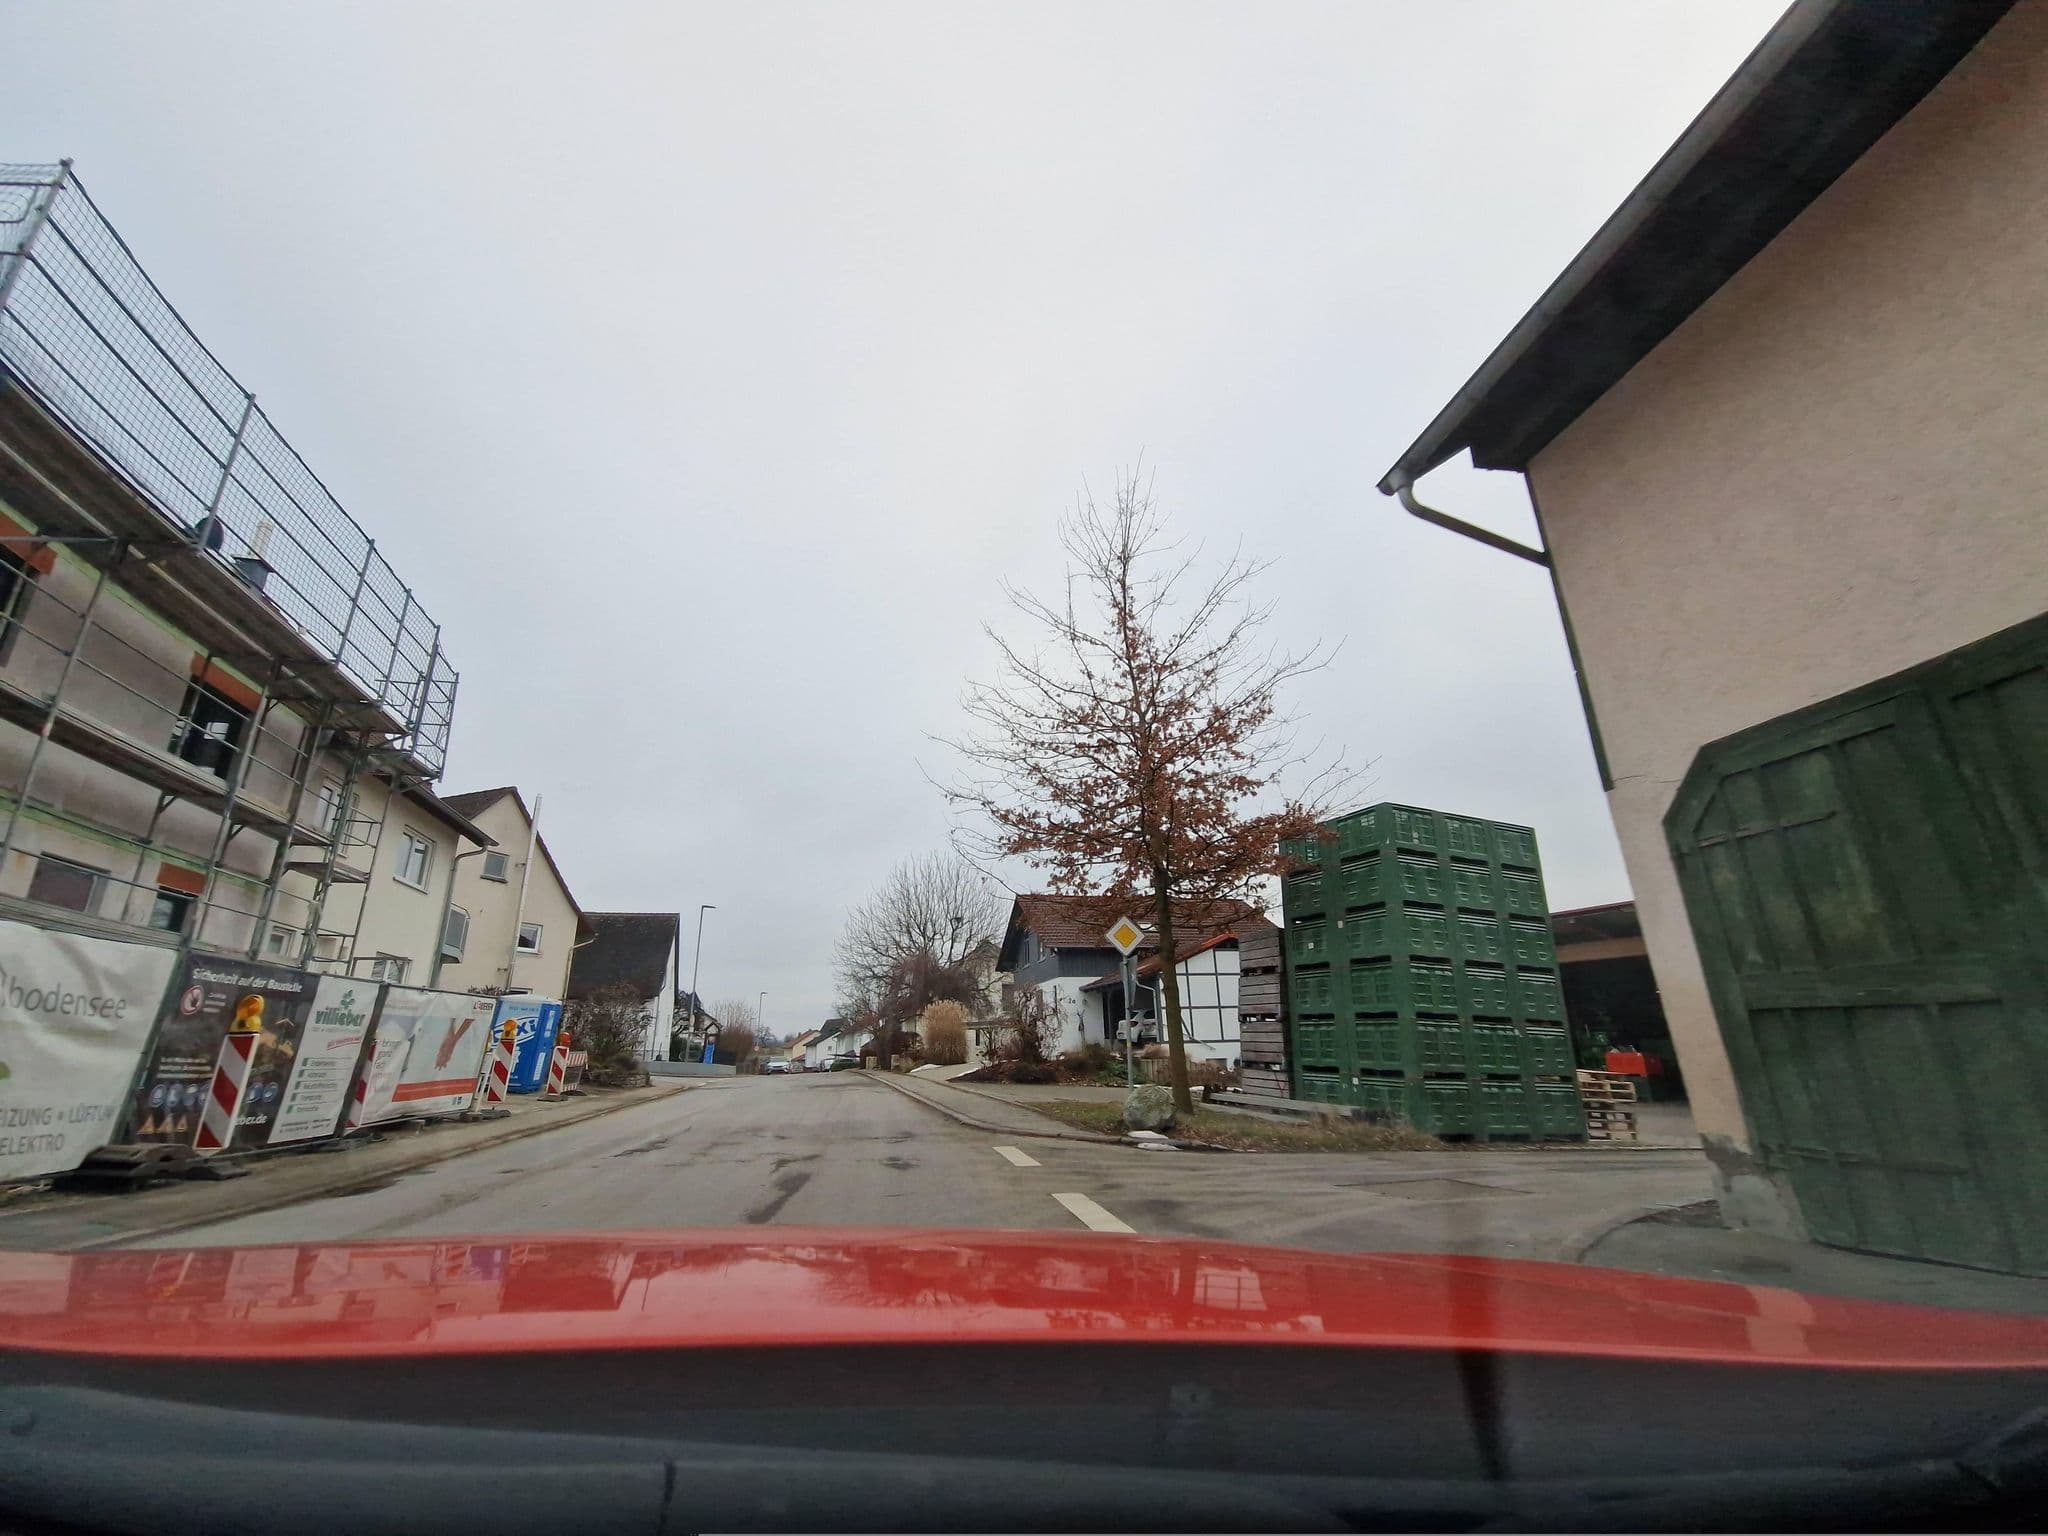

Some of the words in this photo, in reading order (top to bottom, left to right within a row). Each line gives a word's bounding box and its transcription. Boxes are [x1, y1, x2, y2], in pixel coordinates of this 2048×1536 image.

[9, 975, 128, 1019] bodensee
[192, 967, 239, 985] Sicherheit
[238, 976, 255, 988] auf
[251, 977, 268, 989] der
[266, 979, 303, 993] Baustelle
